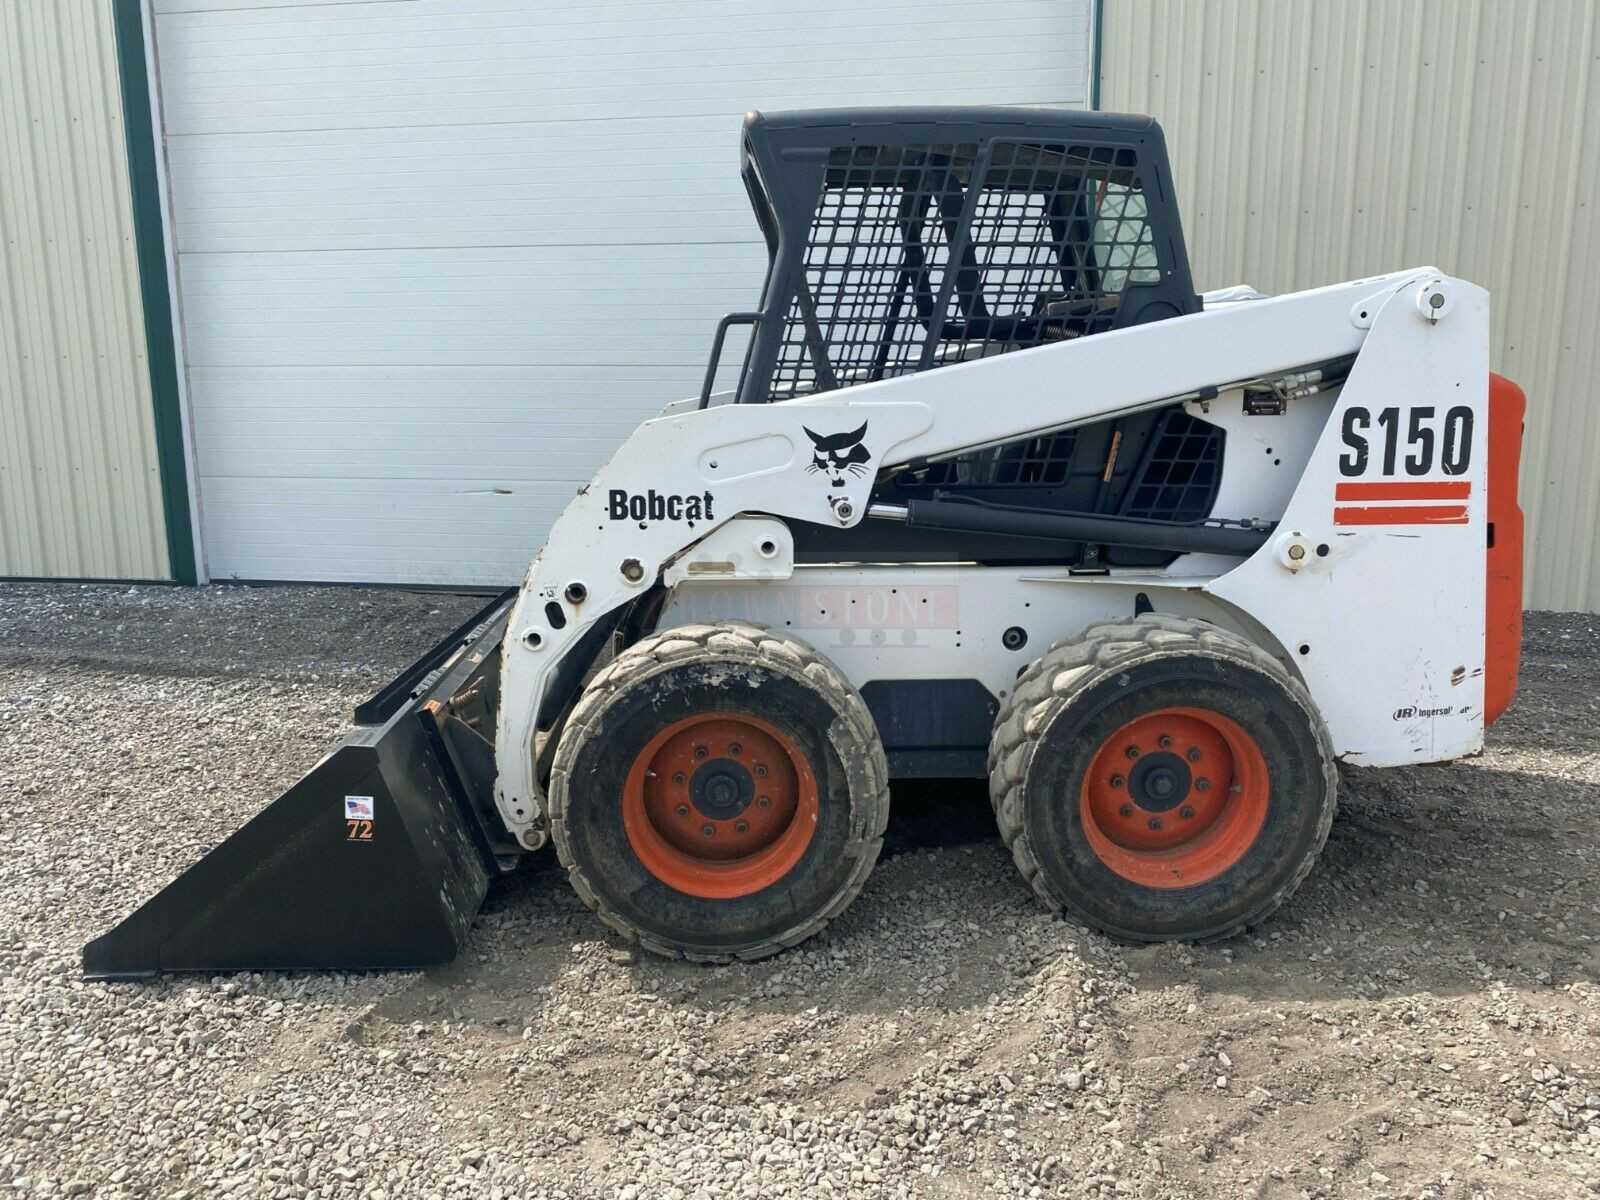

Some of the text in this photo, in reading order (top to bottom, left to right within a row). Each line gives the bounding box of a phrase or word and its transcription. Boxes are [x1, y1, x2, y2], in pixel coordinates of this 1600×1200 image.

[1339, 405, 1474, 477] S150
[609, 489, 714, 520] Bobcat
[1419, 706, 1453, 718] Ingersol
[347, 820, 373, 839] 72
